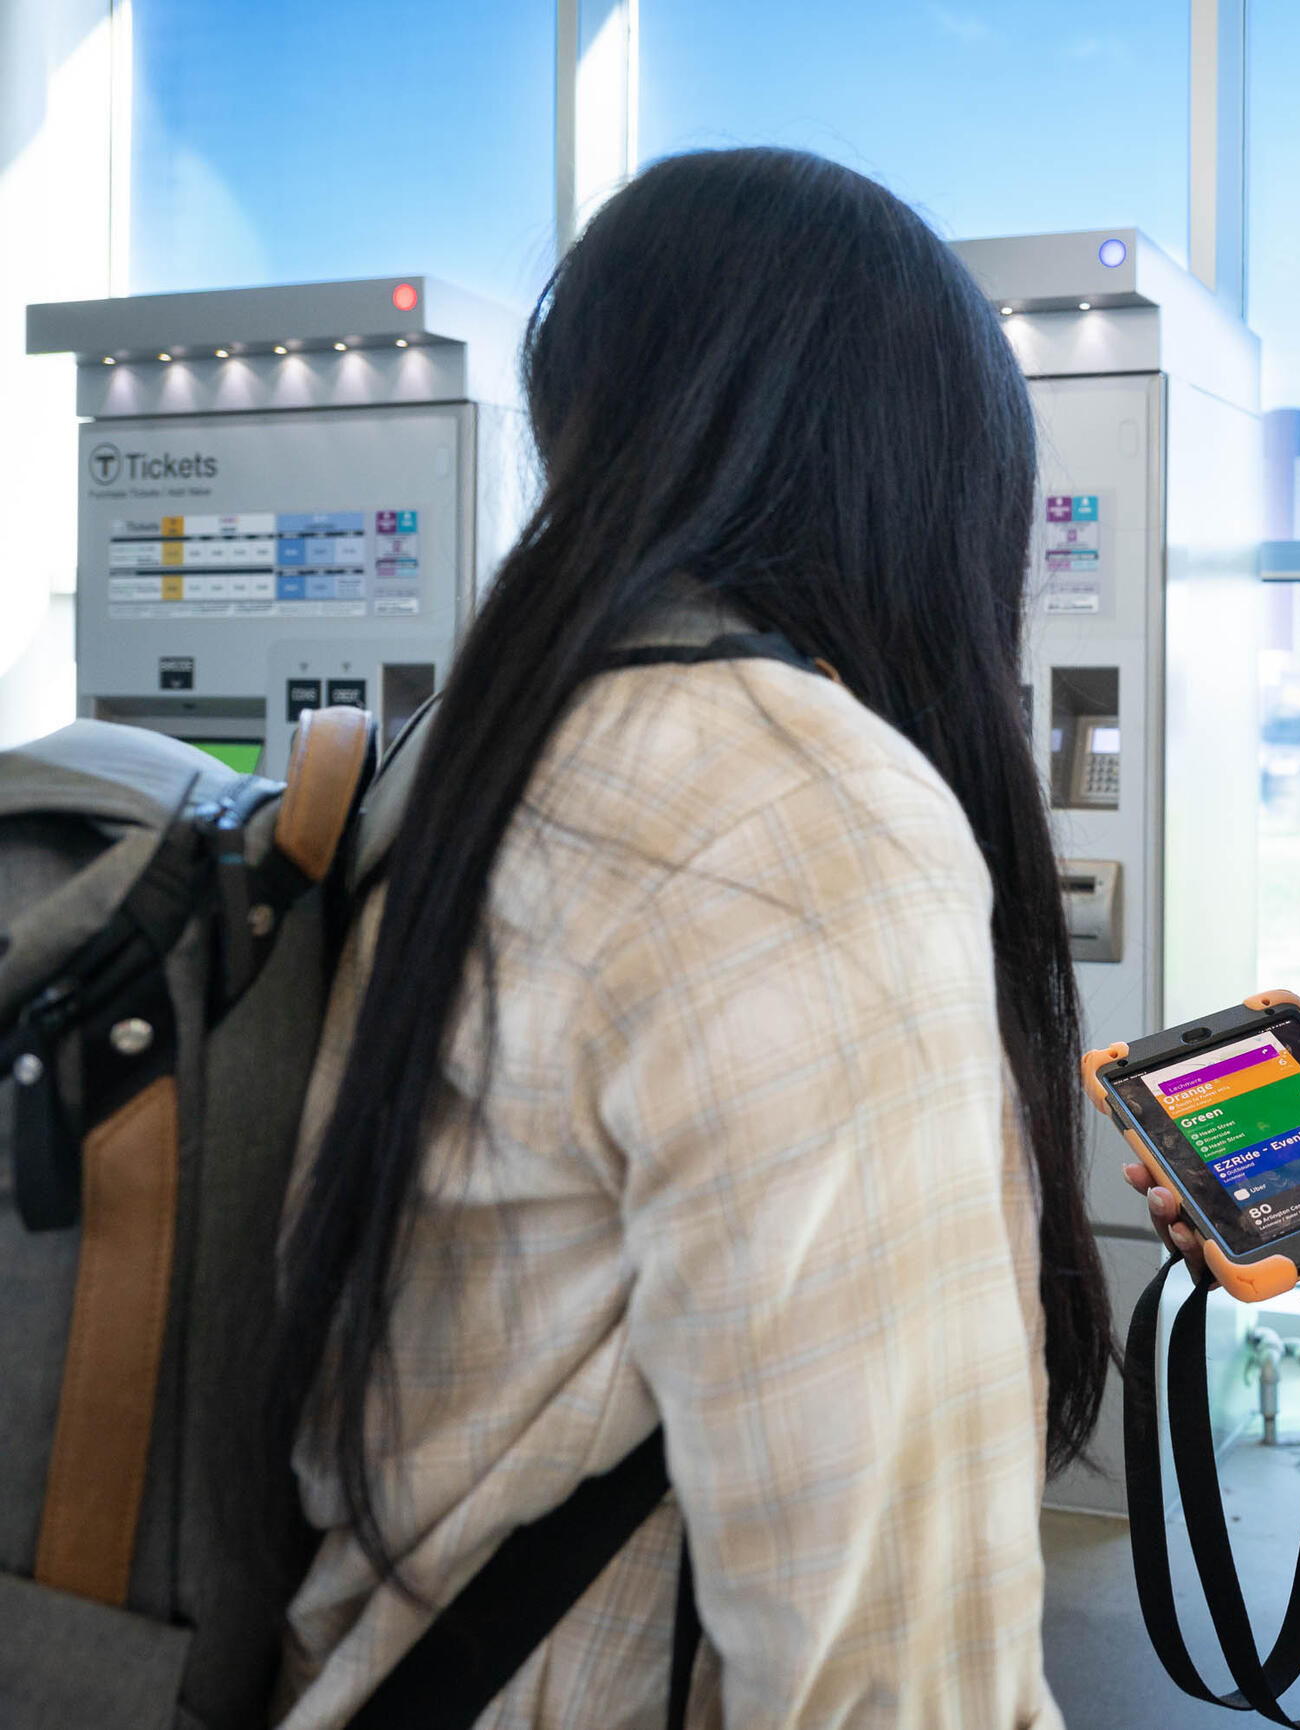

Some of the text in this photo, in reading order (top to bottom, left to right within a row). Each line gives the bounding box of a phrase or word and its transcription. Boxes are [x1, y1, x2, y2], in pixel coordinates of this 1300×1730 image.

[125, 452, 218, 480] Tickets
[1163, 1082, 1214, 1105] Orange
[1169, 1077, 1202, 1093] Lechmere
[1181, 1108, 1224, 1128] Green
[1198, 1128, 1217, 1138] Heath
[1217, 1120, 1236, 1131] Street
[1203, 1130, 1231, 1144] Riverside
[1208, 1132, 1245, 1150] Heath Street
[1213, 1149, 1261, 1174] EZRide
[1226, 1161, 1256, 1176] Outbound
[1249, 1183, 1267, 1194] Uber
[1248, 1203, 1272, 1219] 80
[1262, 1208, 1290, 1223] Arlington
